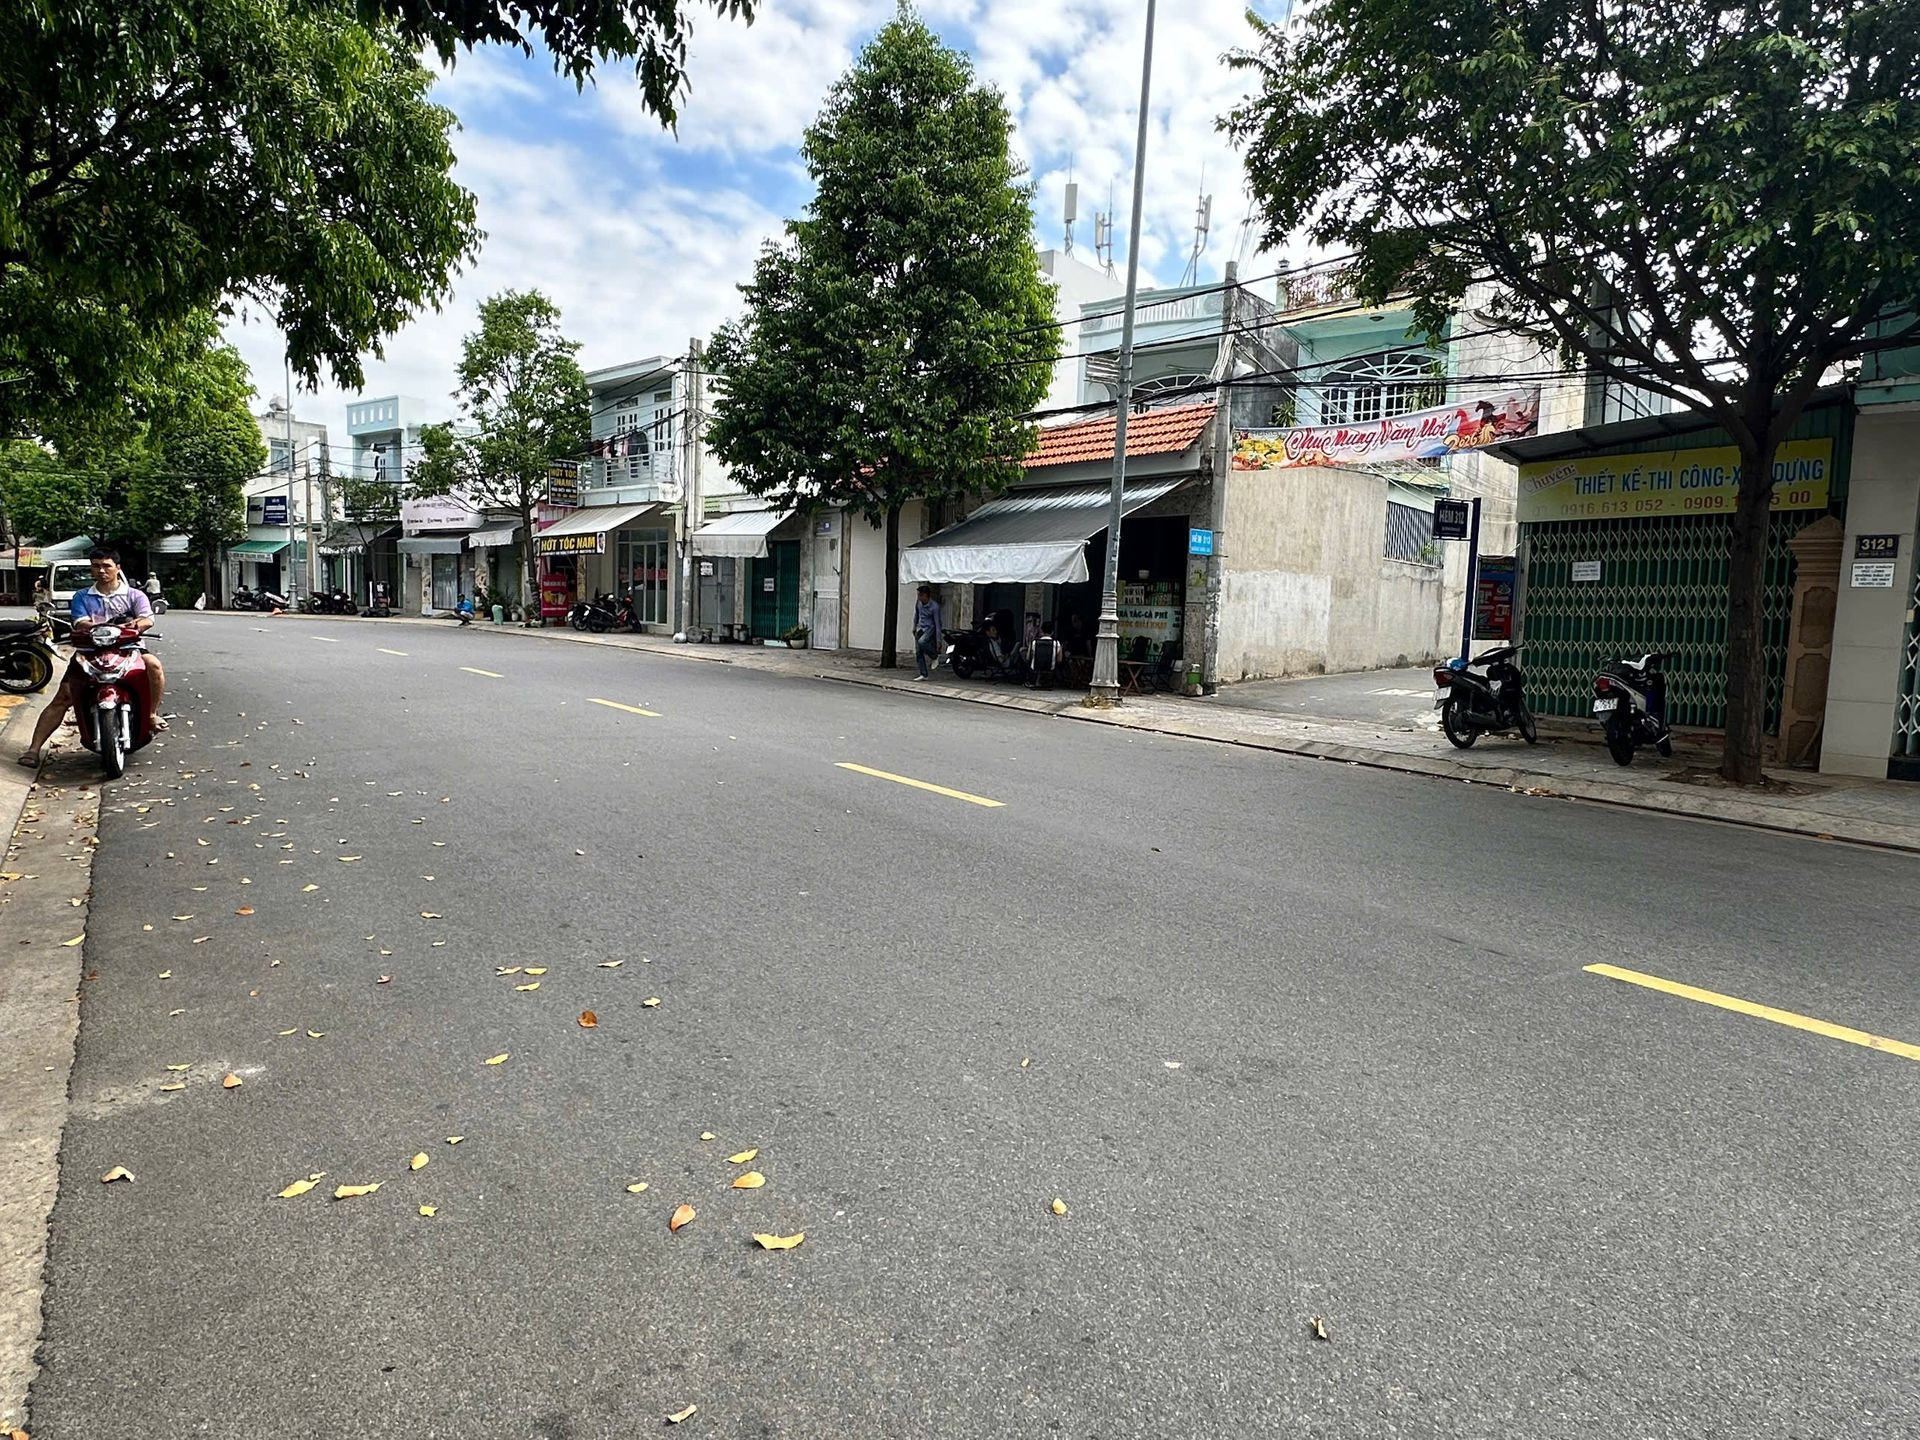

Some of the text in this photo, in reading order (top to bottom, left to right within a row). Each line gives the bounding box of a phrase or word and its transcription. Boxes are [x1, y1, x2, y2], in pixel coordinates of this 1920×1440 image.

[1285, 427, 1331, 460] Chúc
[1377, 420, 1417, 449] Năm
[1444, 435, 1479, 451] 2026
[1575, 458, 1824, 495] THIẾT KẾ-THI CÔNG-X DỰNG
[1561, 500, 1628, 516] 0916.613
[1636, 499, 1663, 511] 052
[1684, 496, 1740, 509] 0909.1
[1454, 510, 1465, 525] 312
[559, 535, 576, 549] TÓC
[576, 536, 595, 549] NAM
